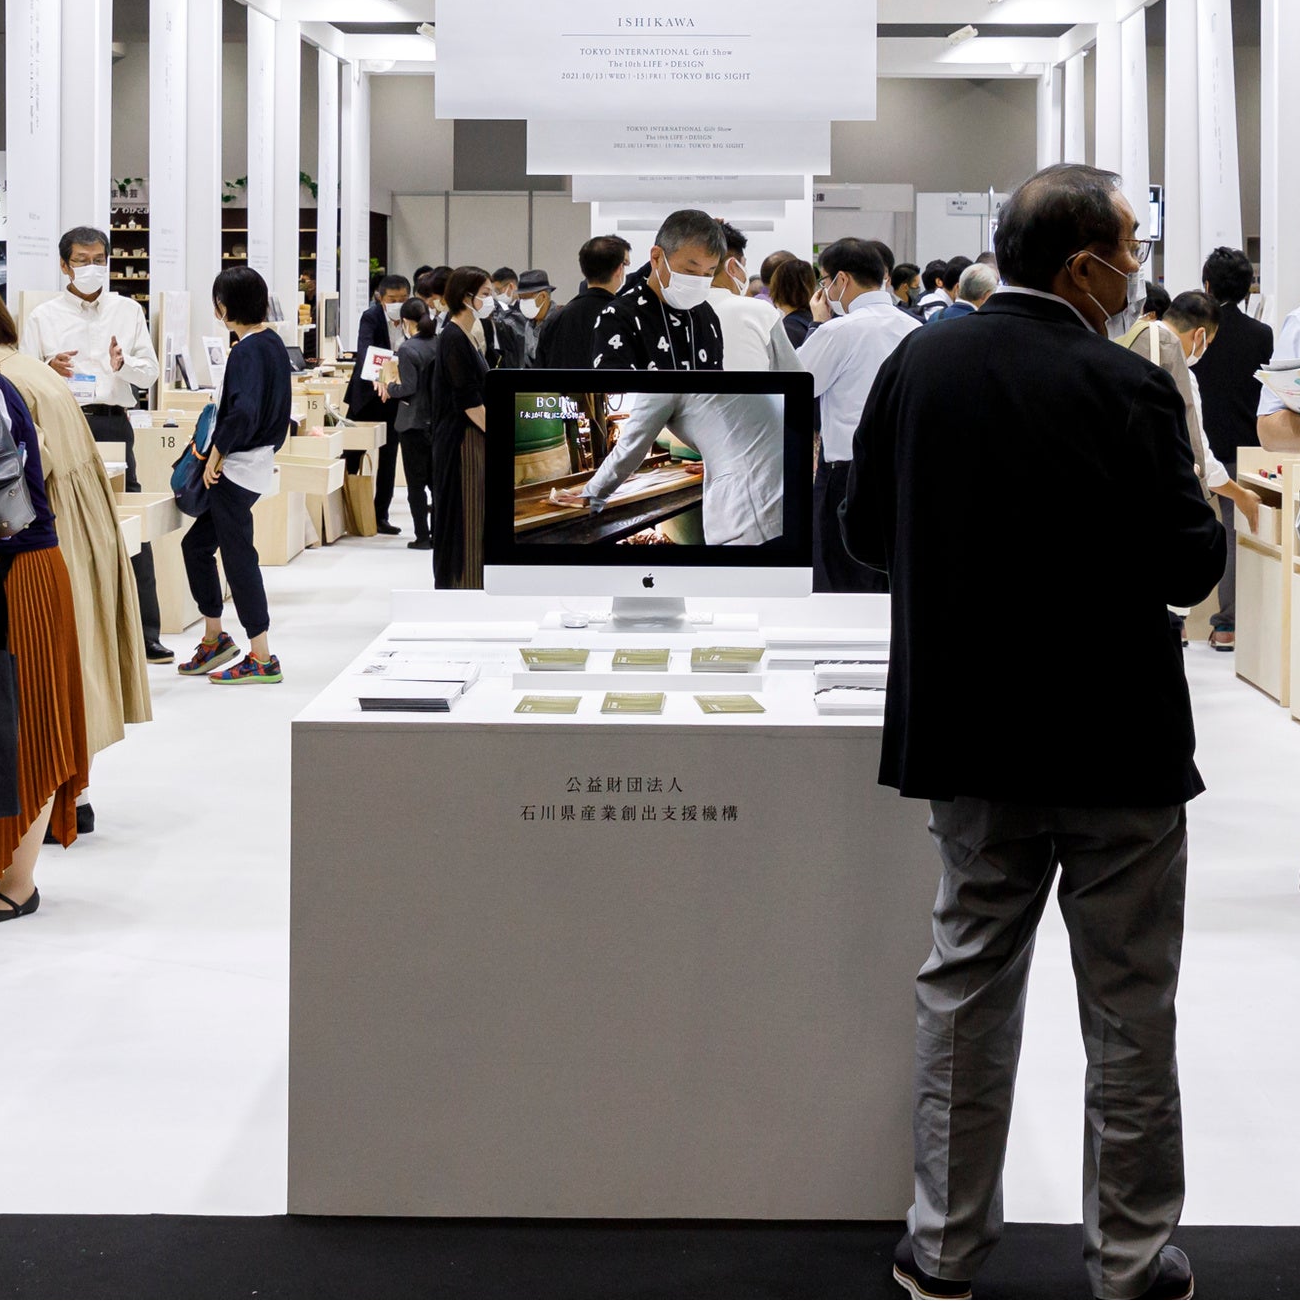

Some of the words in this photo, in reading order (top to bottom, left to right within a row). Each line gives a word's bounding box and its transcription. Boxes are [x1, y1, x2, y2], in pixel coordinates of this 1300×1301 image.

[617, 17, 695, 28] ISHIKAWA
[579, 47, 612, 56] TOKYO
[614, 48, 690, 56] INTERNATIONAL
[692, 48, 709, 56] Gift
[711, 48, 733, 56] Show
[608, 60, 623, 68] The
[624, 60, 642, 68] 10th
[643, 60, 663, 68] LIFE
[670, 60, 704, 69] DESIGN
[670, 72, 703, 80] TOKYO
[705, 72, 722, 81] BIG
[723, 72, 751, 81] SIGHT
[608, 333, 624, 350] 4
[657, 336, 670, 352] 4
[307, 400, 318, 410] 15
[160, 436, 176, 449] 18
[566, 775, 684, 794] 公益財団法人
[520, 803, 739, 823] 石川県産業創出支援機構
